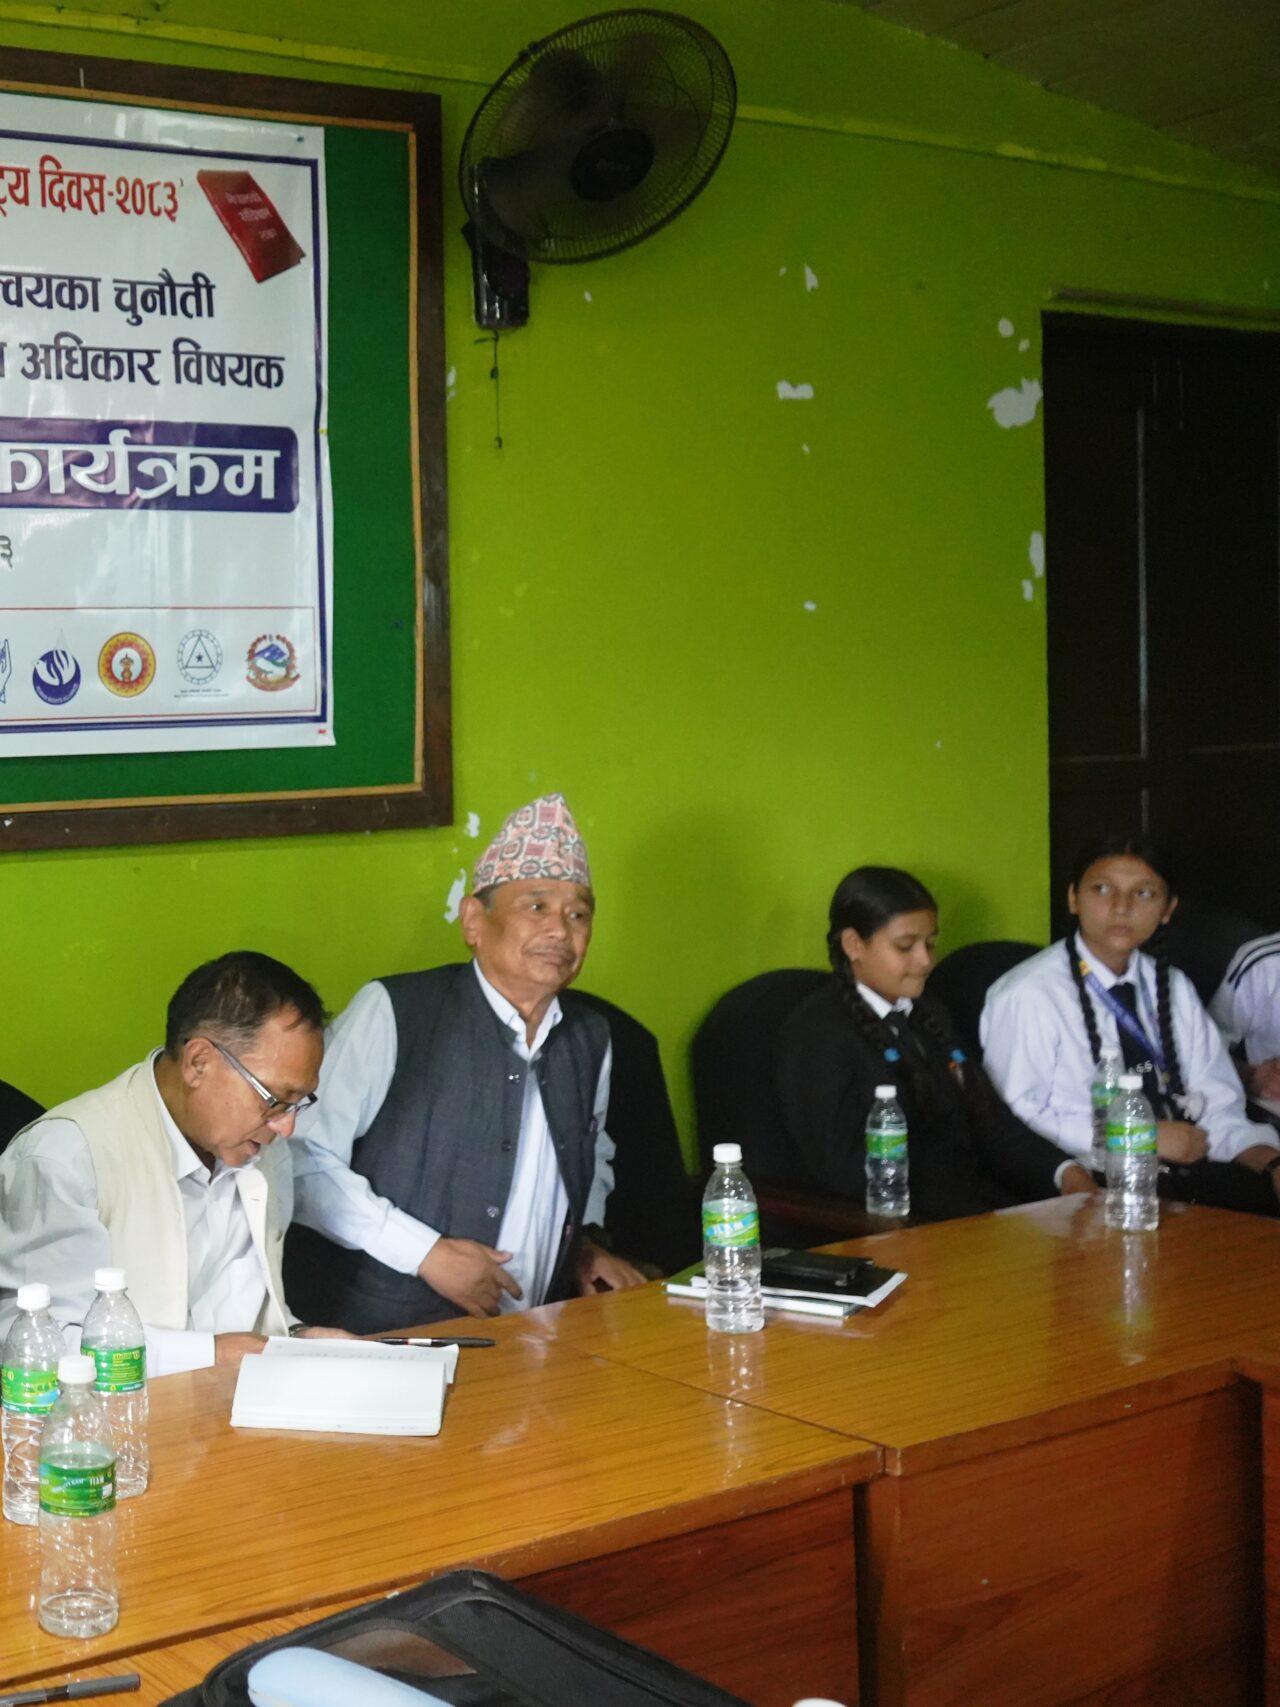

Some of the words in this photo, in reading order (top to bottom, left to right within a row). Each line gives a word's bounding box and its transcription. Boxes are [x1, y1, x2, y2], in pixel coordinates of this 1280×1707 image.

[113, 268, 216, 326] चुनौती
[19, 331, 161, 386] अधिकार
[172, 337, 286, 389] विषयक
